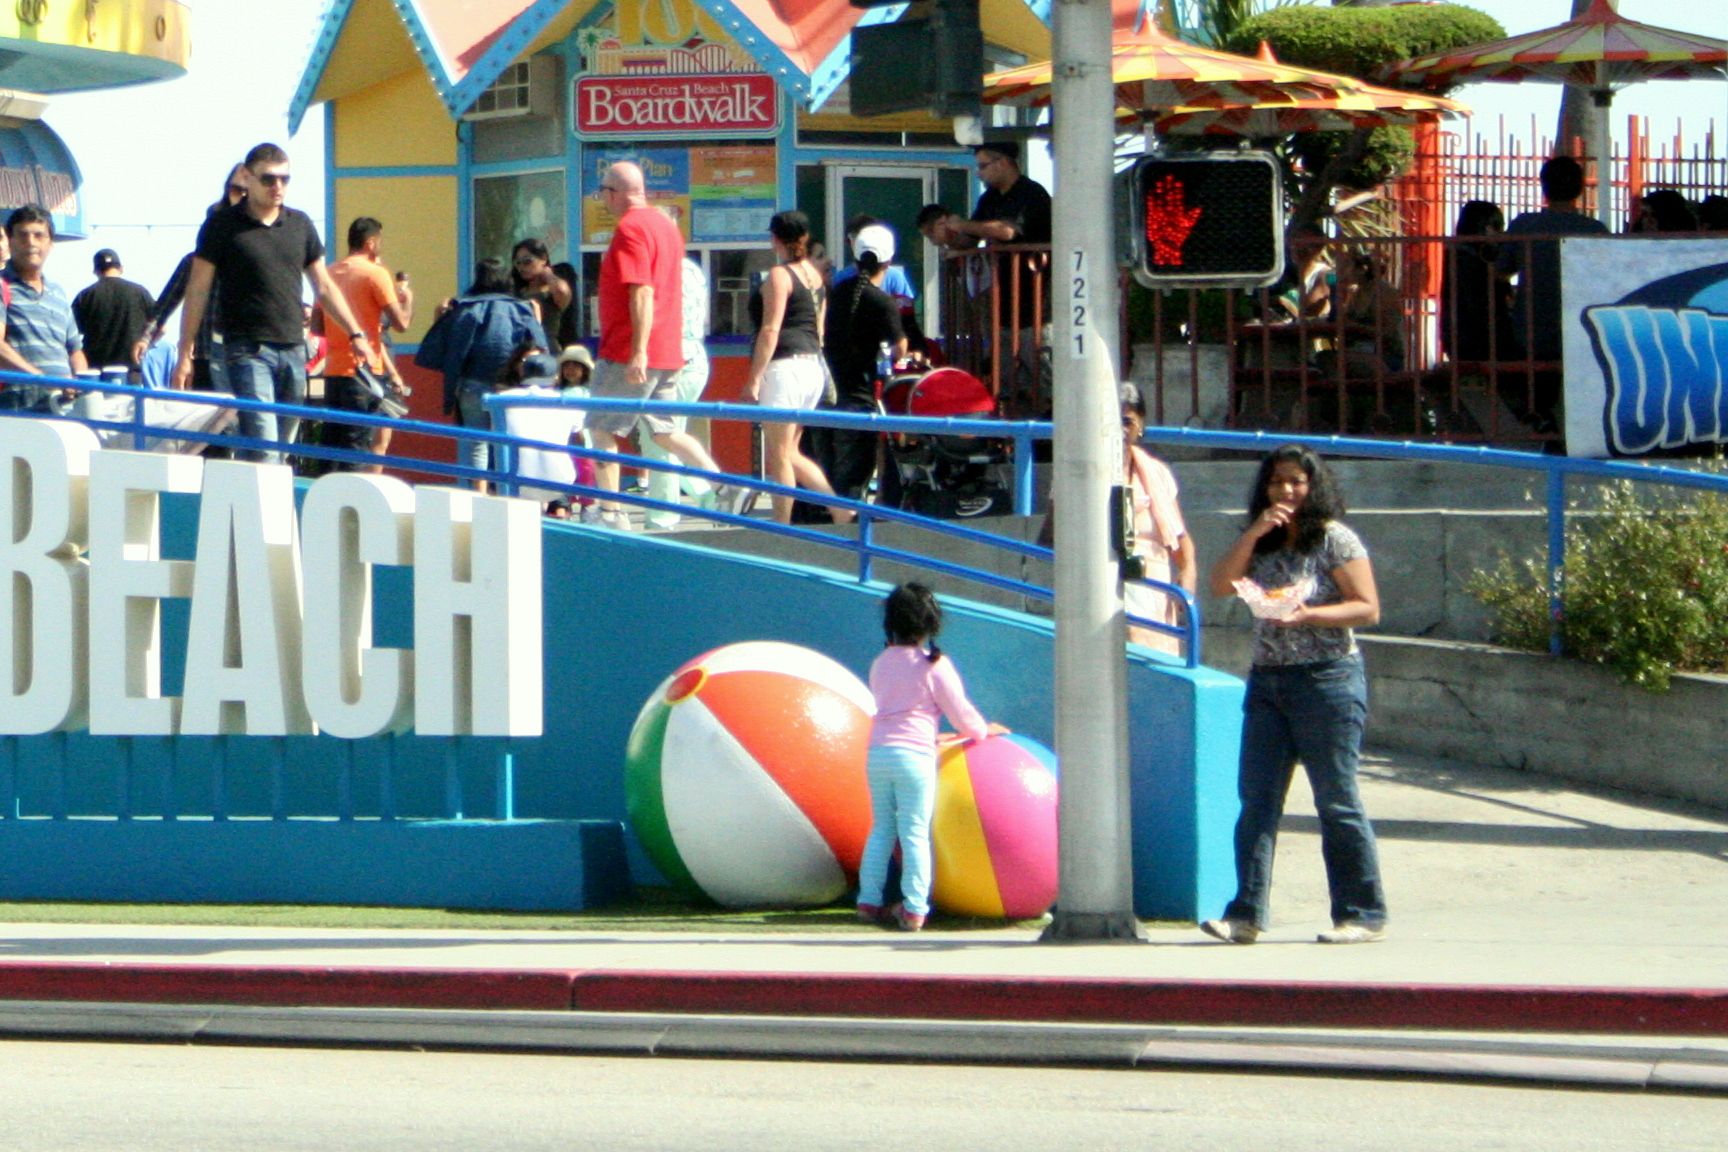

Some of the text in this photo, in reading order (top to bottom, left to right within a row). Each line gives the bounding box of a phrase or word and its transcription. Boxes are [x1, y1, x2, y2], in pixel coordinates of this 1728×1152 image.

[614, 82, 730, 97] Santa Cruz Beach
[583, 84, 769, 125] Boardwalk
